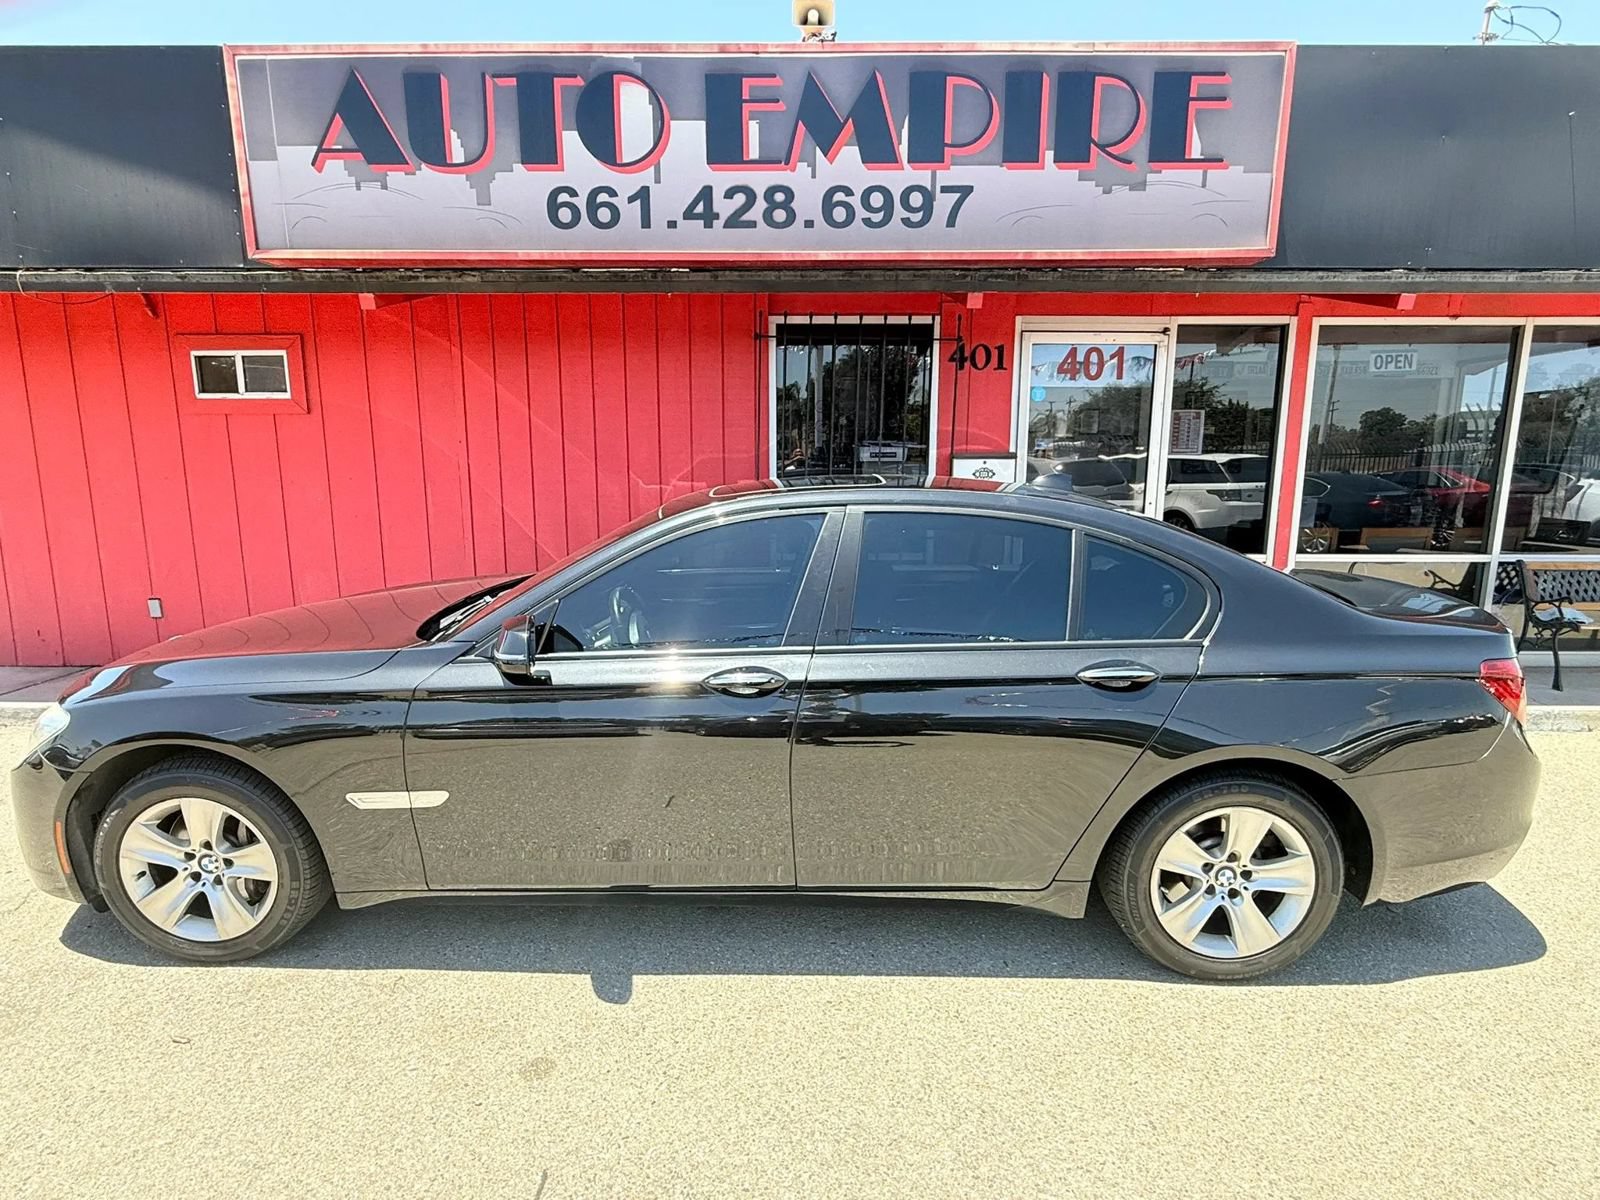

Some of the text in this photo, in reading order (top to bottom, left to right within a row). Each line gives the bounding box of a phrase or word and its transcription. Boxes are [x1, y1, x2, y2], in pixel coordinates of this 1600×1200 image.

[311, 66, 1233, 174] AUTO EMPIRE
[546, 184, 975, 230] 661.428.6997
[947, 342, 1008, 371] 401
[1057, 345, 1126, 382] 401
[1373, 353, 1414, 371] OPEN
